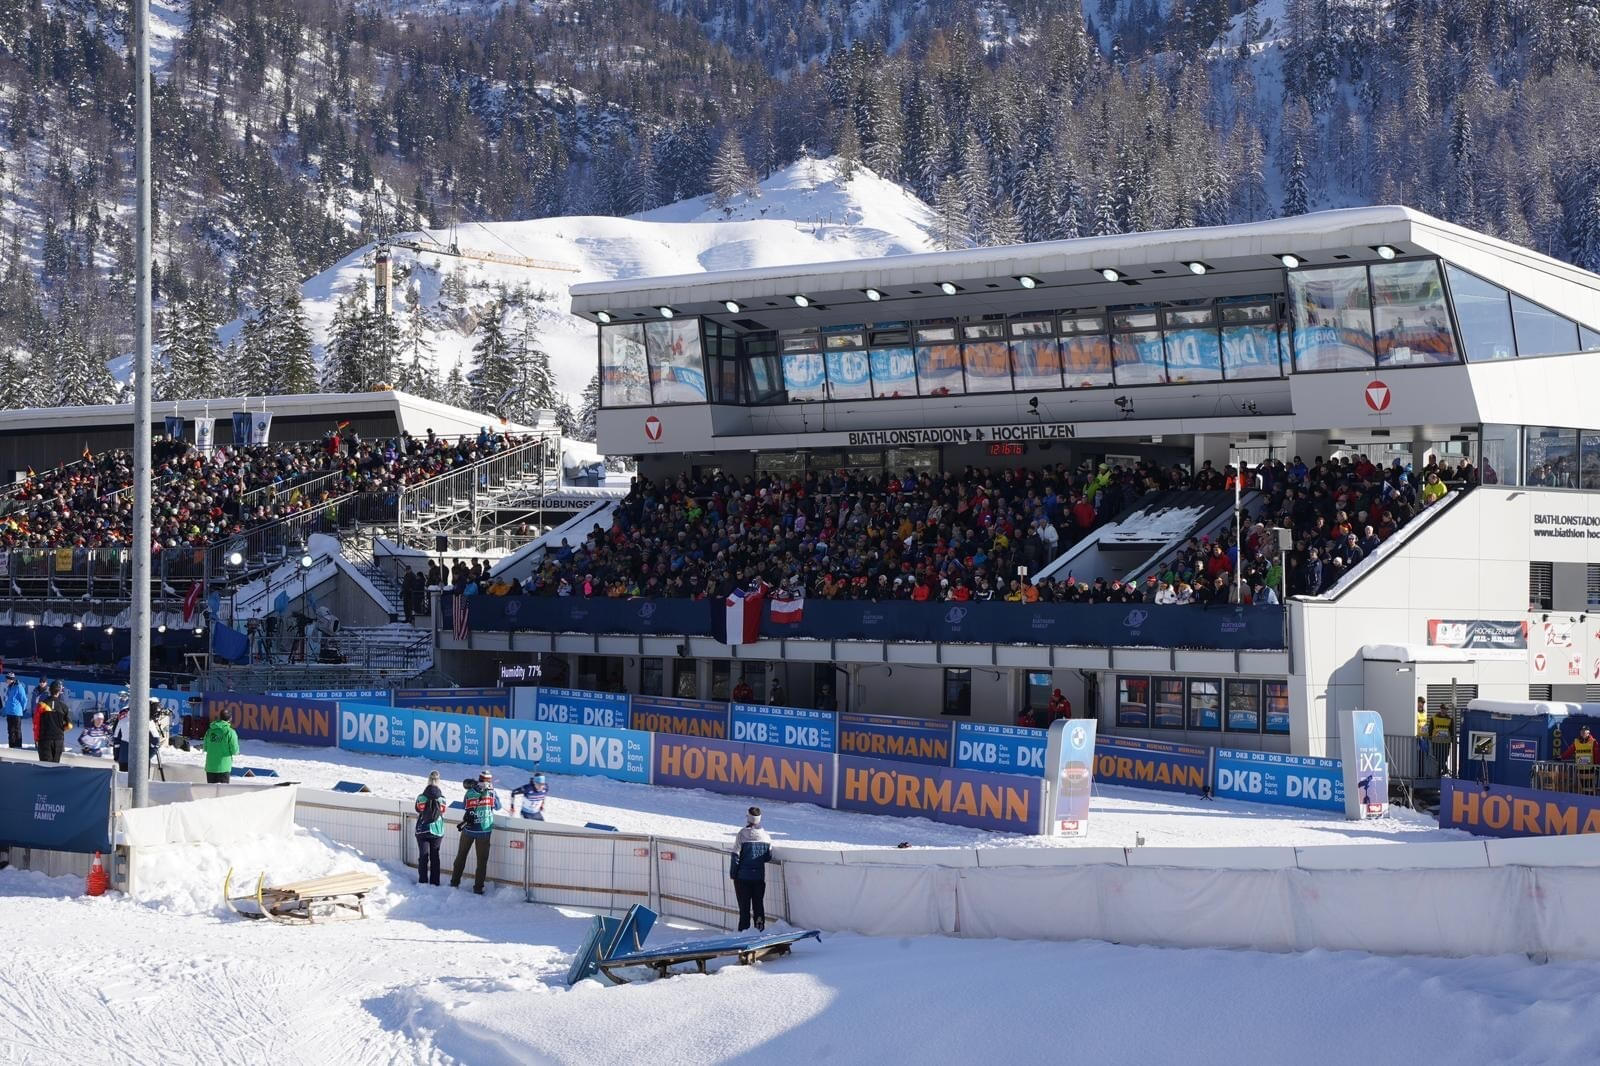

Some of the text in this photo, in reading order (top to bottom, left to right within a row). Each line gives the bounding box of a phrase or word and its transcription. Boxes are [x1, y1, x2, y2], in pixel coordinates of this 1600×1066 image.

[849, 424, 1074, 446] BIATHLONSTADION HOCHFILZEN
[502, 665, 542, 680] Humidity 77%
[392, 717, 402, 726] Das
[538, 703, 568, 723] DKB
[584, 707, 614, 727] DKB
[343, 712, 389, 744] DKB
[392, 728, 405, 736] kann
[464, 725, 476, 734] Das
[633, 712, 725, 738] HÖRMANN
[735, 721, 768, 742] DKB
[392, 738, 405, 746] Bank
[413, 719, 462, 753] DKB
[464, 736, 478, 745] kann
[492, 727, 543, 761] DKB
[547, 732, 558, 741] Das
[628, 740, 640, 750] Das
[785, 726, 819, 747] DKB
[841, 730, 947, 760] HÖRMANN
[464, 746, 478, 756] Bank
[546, 743, 561, 752] kann
[570, 734, 624, 770] DKB
[627, 751, 643, 762] kann
[959, 741, 996, 764] DKB
[1017, 746, 1046, 768] DK
[546, 754, 562, 763] Bank
[627, 762, 643, 773] Bank
[1360, 753, 1382, 772] iX2
[661, 744, 823, 795] HÖRMANN
[1218, 769, 1262, 794] DKB
[1286, 775, 1332, 800] DKB
[846, 768, 1029, 822] HÖRMANN
[34, 812, 56, 820] FAMILY
[35, 803, 65, 812] BIATHLON
